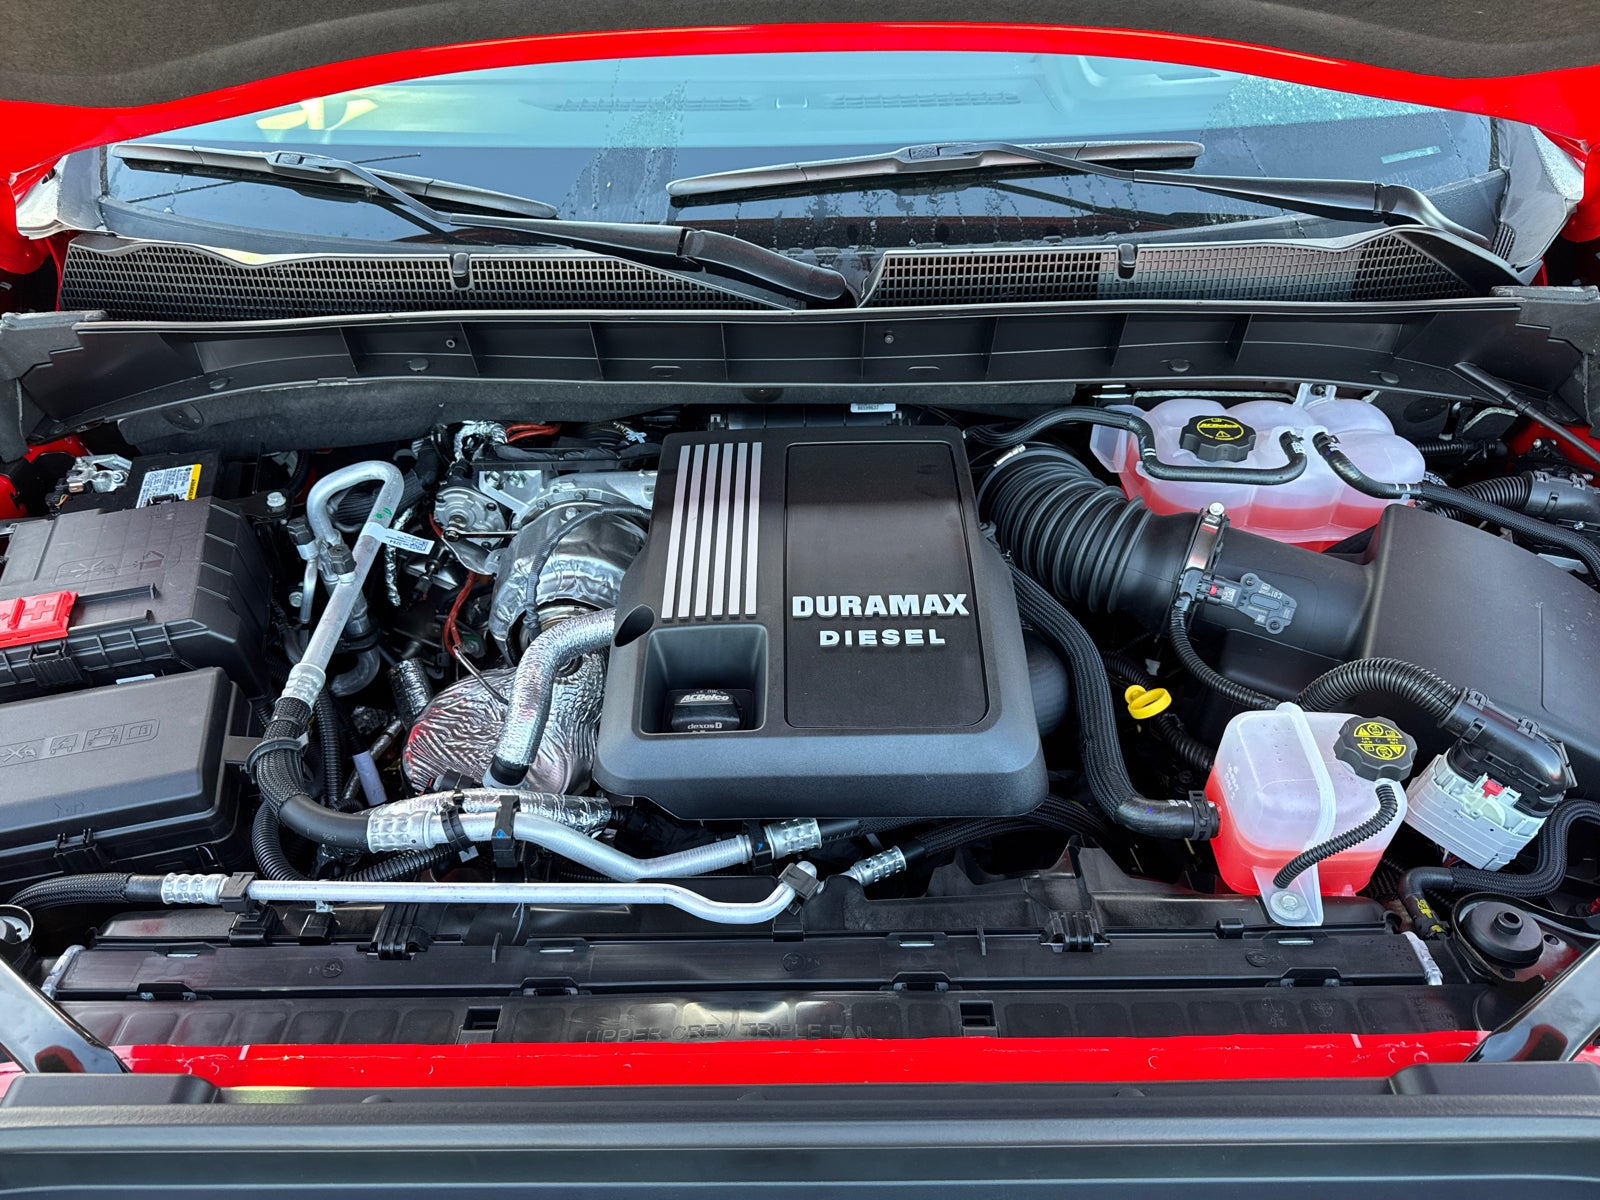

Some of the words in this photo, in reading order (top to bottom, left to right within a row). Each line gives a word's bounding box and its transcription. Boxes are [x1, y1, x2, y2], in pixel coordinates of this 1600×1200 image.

[792, 594, 970, 618] DURAMAX
[819, 629, 946, 648] DIESEL
[680, 693, 730, 704] ACDelco
[585, 1026, 662, 1043] UPPER
[742, 1022, 822, 1040] TRIPLE
[829, 1023, 873, 1039] FAN
